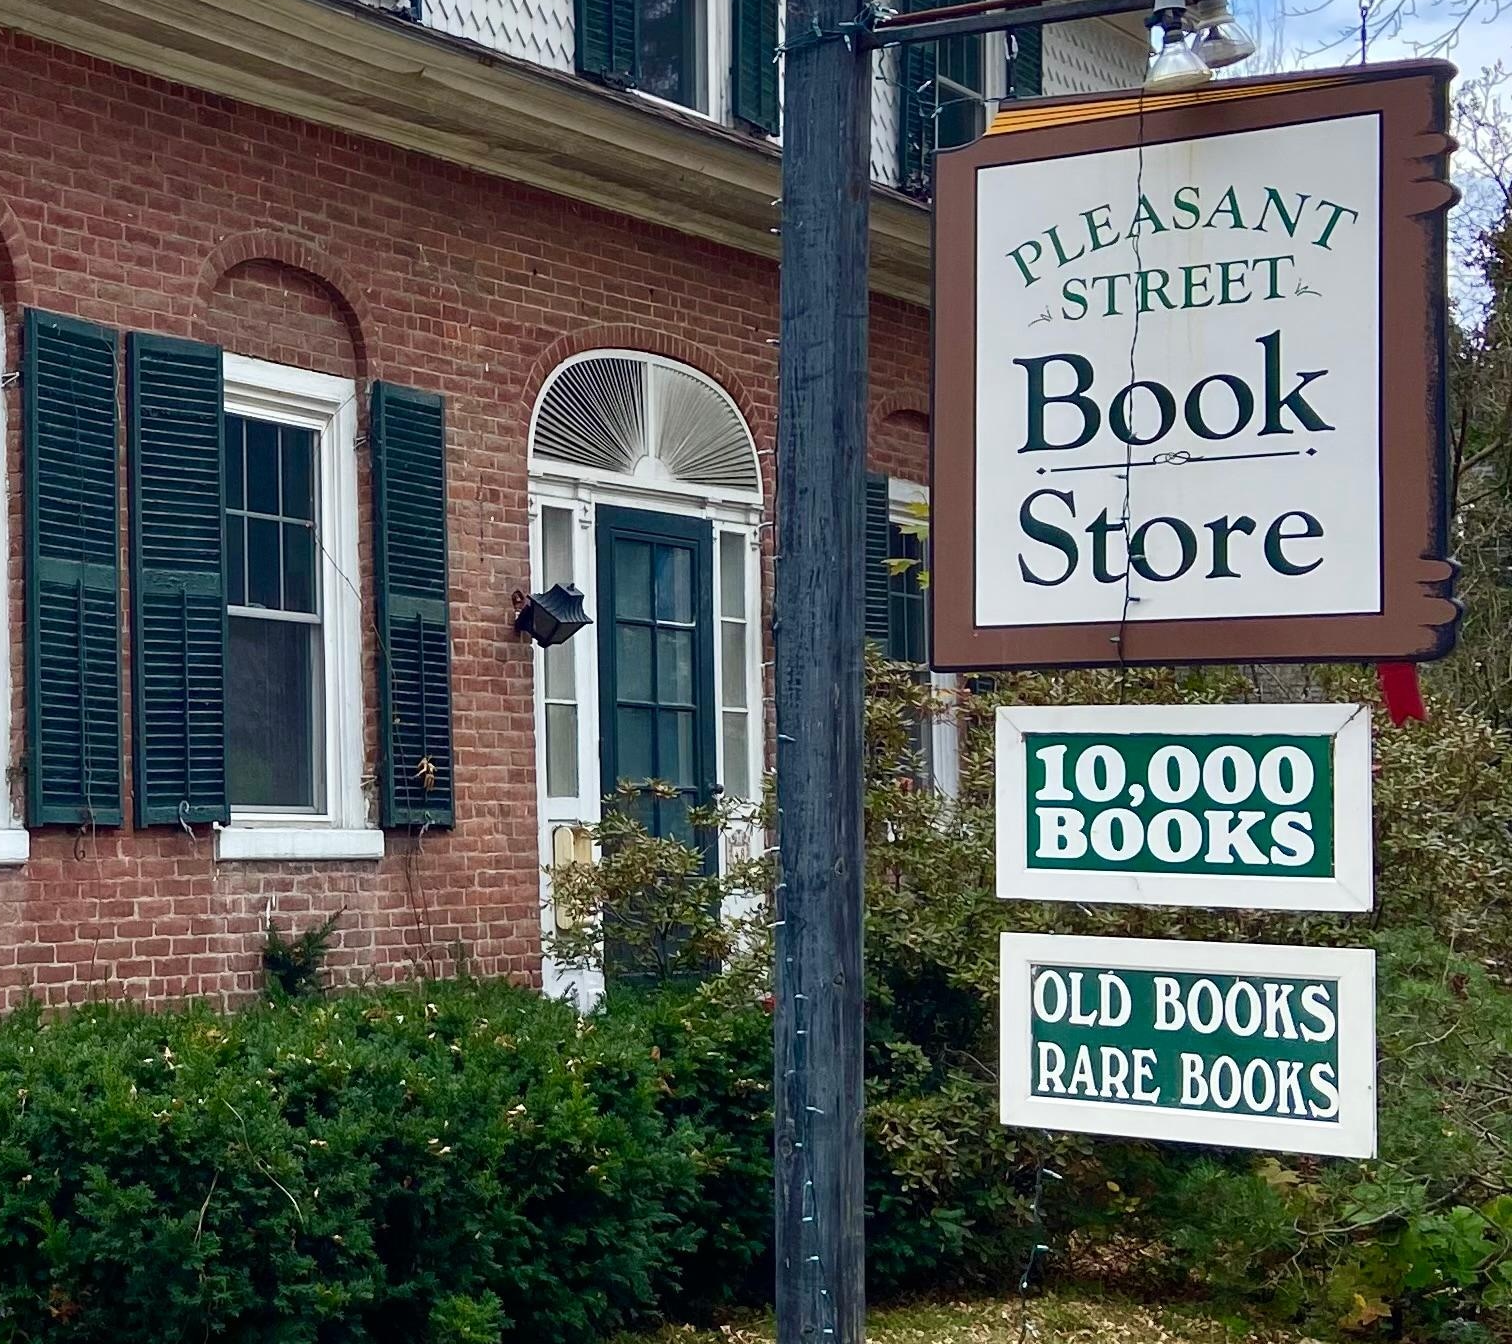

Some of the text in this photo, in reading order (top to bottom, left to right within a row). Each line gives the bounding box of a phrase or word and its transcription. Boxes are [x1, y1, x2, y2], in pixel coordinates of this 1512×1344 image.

[1006, 185, 1358, 288] PLEASANT
[1061, 255, 1295, 321] STREET
[1012, 329, 1336, 455] Book
[1017, 488, 1325, 587] Store
[1035, 744, 1315, 807] 10,000
[1035, 807, 1315, 867] BOOKS
[1032, 969, 1336, 1043] OLD BOOKS
[1036, 1041, 1340, 1119] RARE BOOKS
